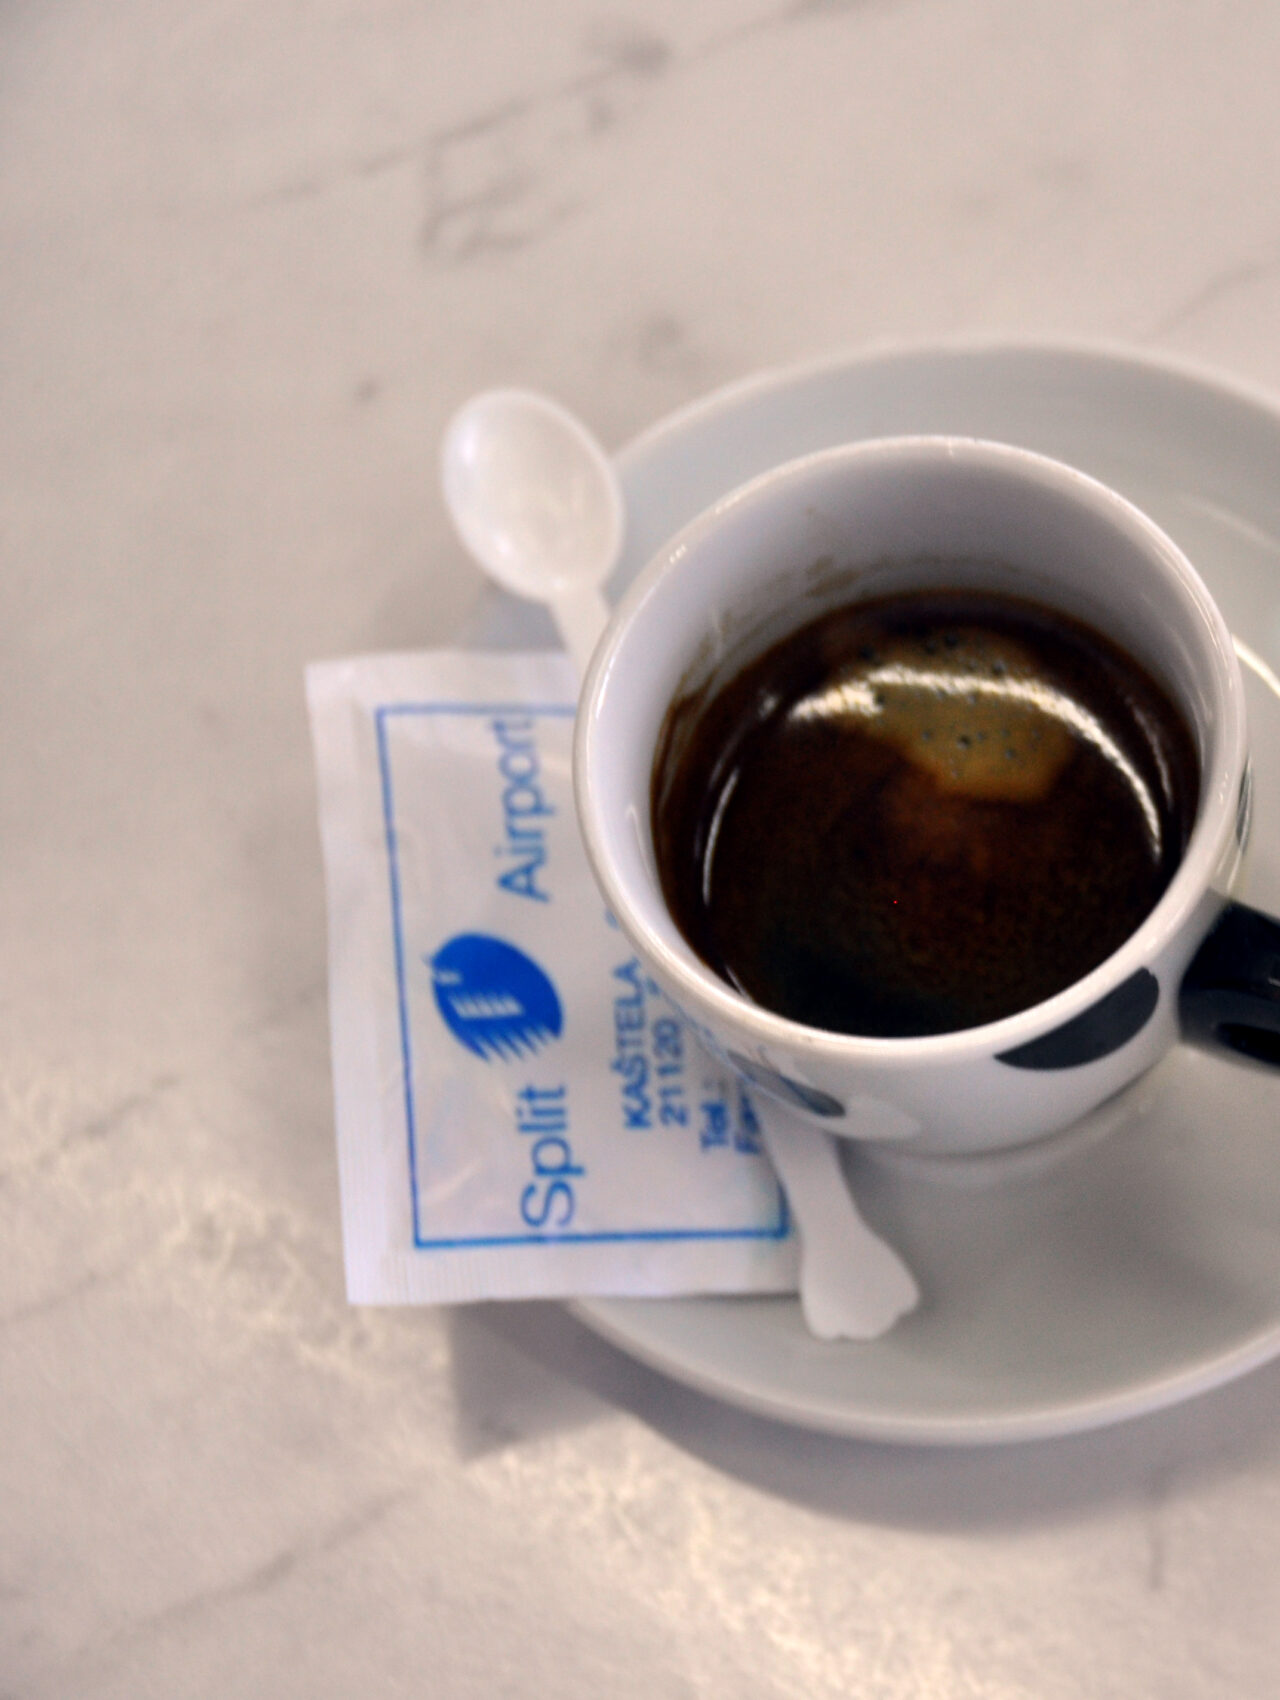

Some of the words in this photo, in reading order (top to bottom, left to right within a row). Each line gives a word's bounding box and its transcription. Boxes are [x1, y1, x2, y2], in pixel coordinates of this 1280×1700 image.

[494, 716, 555, 902] Airport
[611, 957, 652, 1129] KAŠTELA
[518, 1084, 585, 1228] Split
